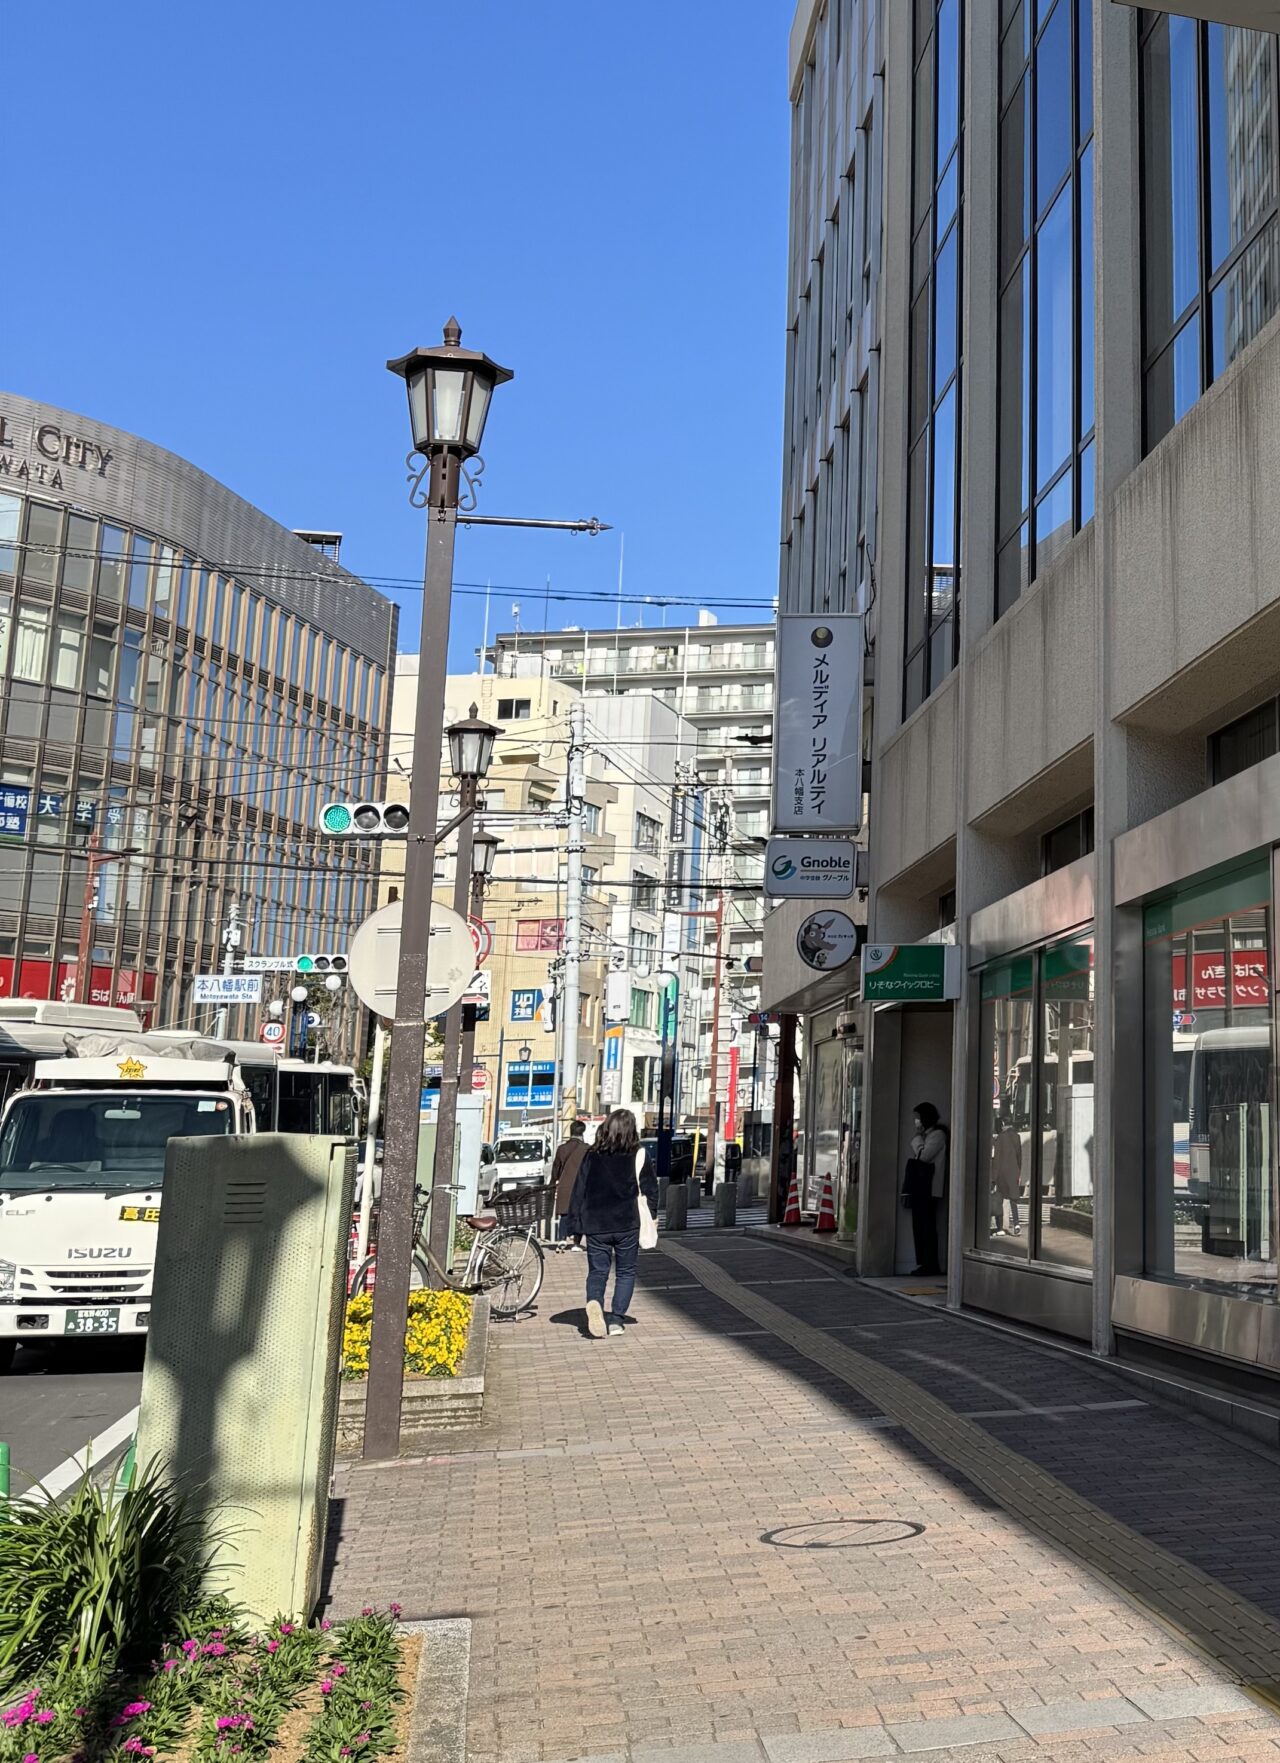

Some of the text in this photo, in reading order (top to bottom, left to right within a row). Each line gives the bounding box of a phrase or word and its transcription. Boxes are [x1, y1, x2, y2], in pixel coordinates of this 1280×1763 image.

[35, 424, 114, 479] CITY
[810, 653, 830, 815] メルディア リアルティ
[793, 768, 805, 815] 本八幡支店
[0, 792, 28, 810] 備校
[801, 856, 850, 868] Gnoble
[248, 960, 293, 968] スクランブル式
[197, 979, 259, 992] 本八幡駅前
[869, 981, 940, 990] りそなクイックロビー
[265, 1026, 280, 1036] 40
[68, 1248, 132, 1259] ISUZU
[76, 1318, 117, 1332] 38-35
